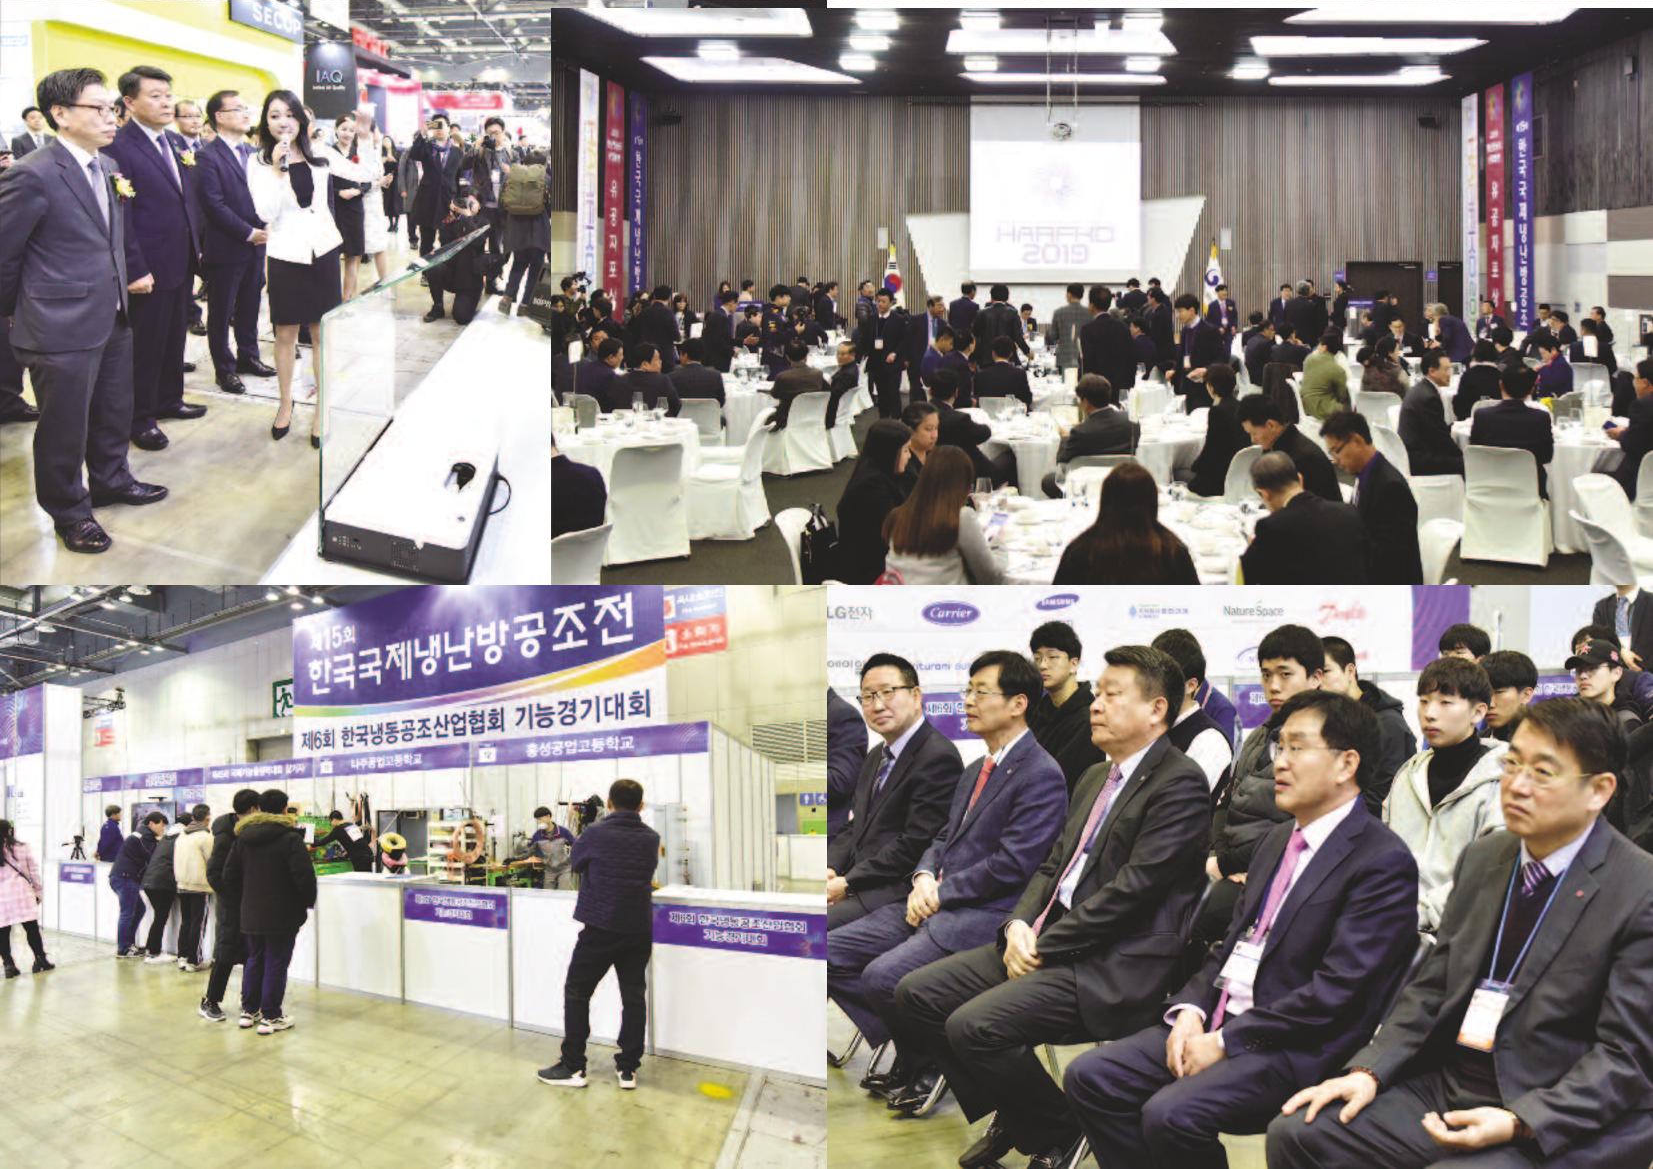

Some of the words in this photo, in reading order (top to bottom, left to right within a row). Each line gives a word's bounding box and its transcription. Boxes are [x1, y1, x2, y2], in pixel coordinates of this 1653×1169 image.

[316, 69, 343, 83] IAQ
[1021, 243, 1089, 264] 2019
[929, 607, 973, 619] Carrier
[1223, 604, 1255, 617] Nature
[1256, 604, 1284, 618] Space
[307, 592, 635, 696] 한국국제냉난방공조전
[301, 728, 336, 752] 제6회
[341, 706, 506, 746] 한국냉동공조산업협회
[515, 688, 652, 731] 기능경기대회
[526, 736, 636, 759] 홍성공업고등학교
